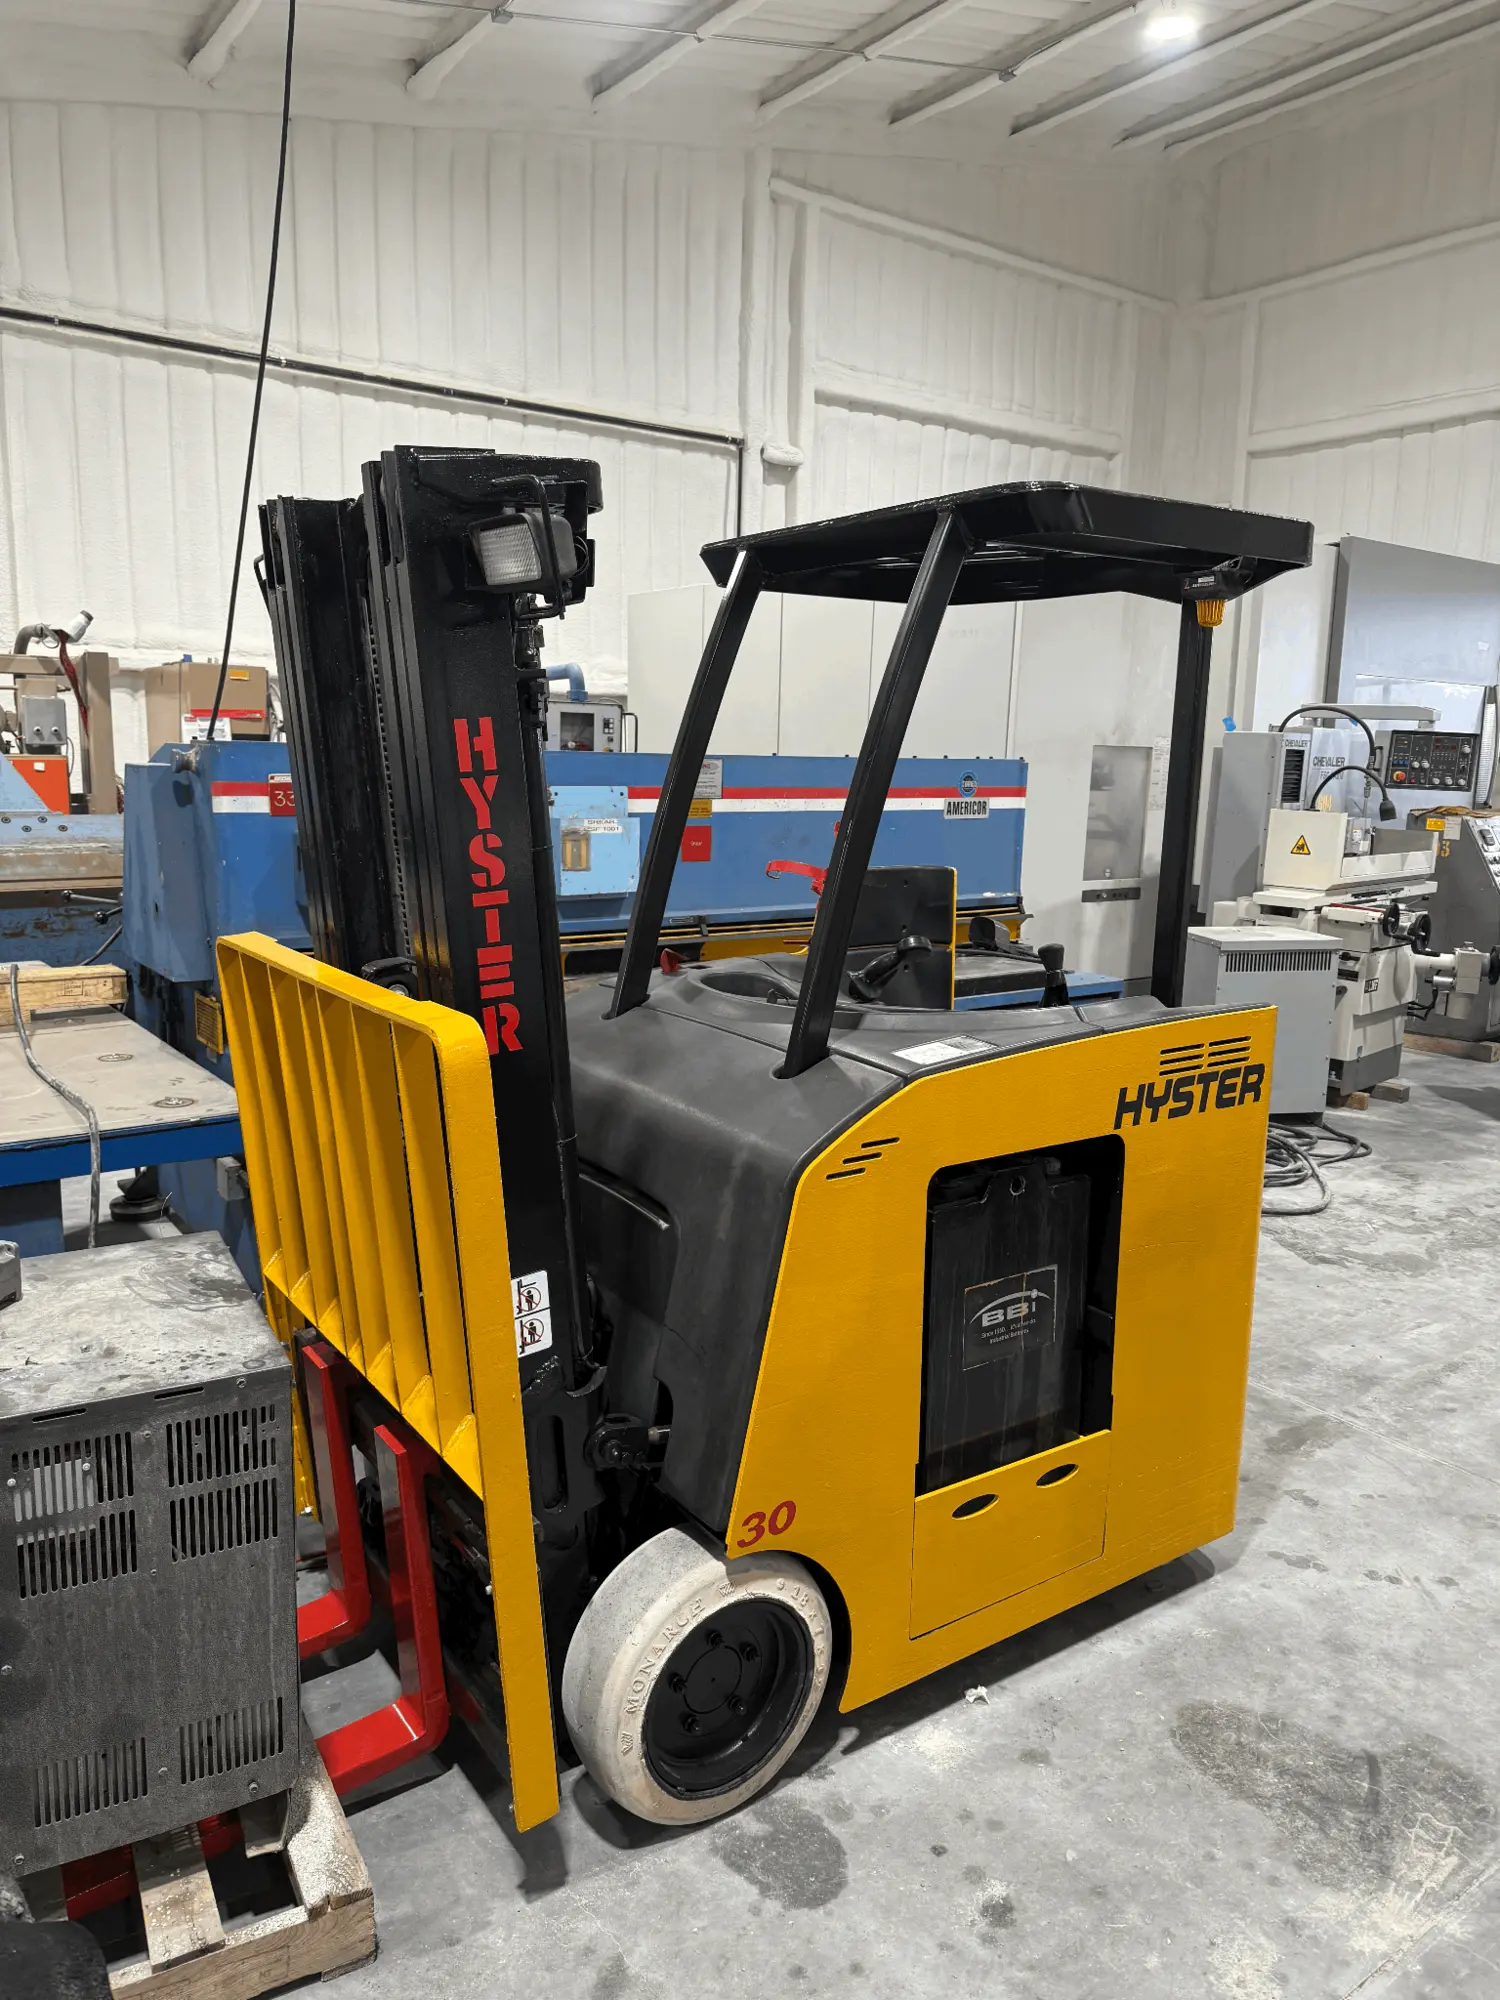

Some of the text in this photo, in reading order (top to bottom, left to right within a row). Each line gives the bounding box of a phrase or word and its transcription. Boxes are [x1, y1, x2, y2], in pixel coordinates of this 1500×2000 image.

[1285, 739, 1309, 748] CHEVALIER
[1313, 756, 1346, 767] CHEVALIER
[946, 801, 987, 816] AMERICOR
[453, 716, 524, 1056] HYSTER
[1113, 1063, 1265, 1131] HYSTER
[737, 1500, 797, 1548] 30
[624, 1598, 706, 1716] MONARCH
